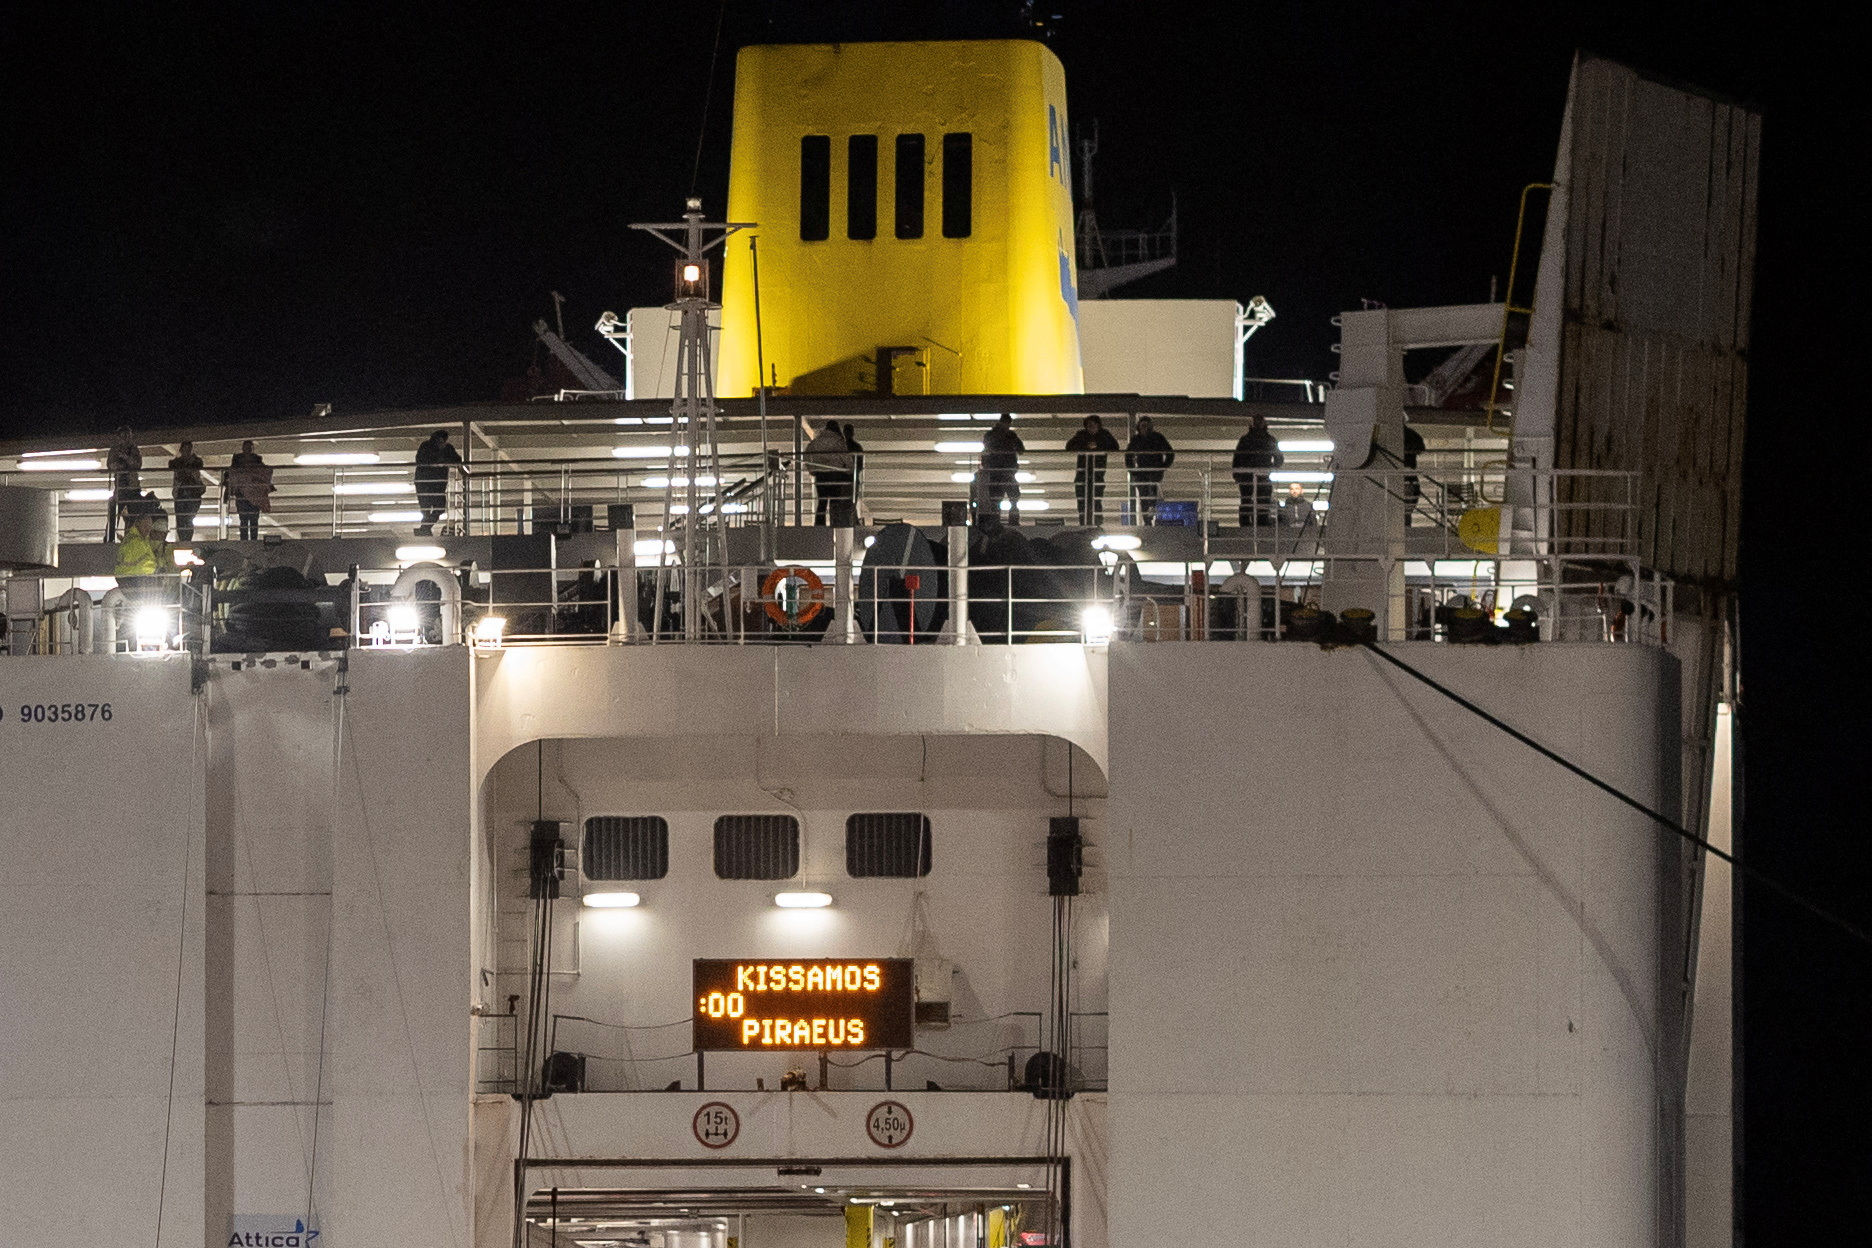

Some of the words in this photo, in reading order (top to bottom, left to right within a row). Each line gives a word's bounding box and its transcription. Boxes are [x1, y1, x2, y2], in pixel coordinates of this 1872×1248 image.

[20, 703, 113, 723] 9035876
[736, 965, 881, 991] KISSAMOS
[699, 992, 745, 1018] :00
[742, 1019, 865, 1045] PIRAEUS
[228, 1231, 300, 1248] Attica
